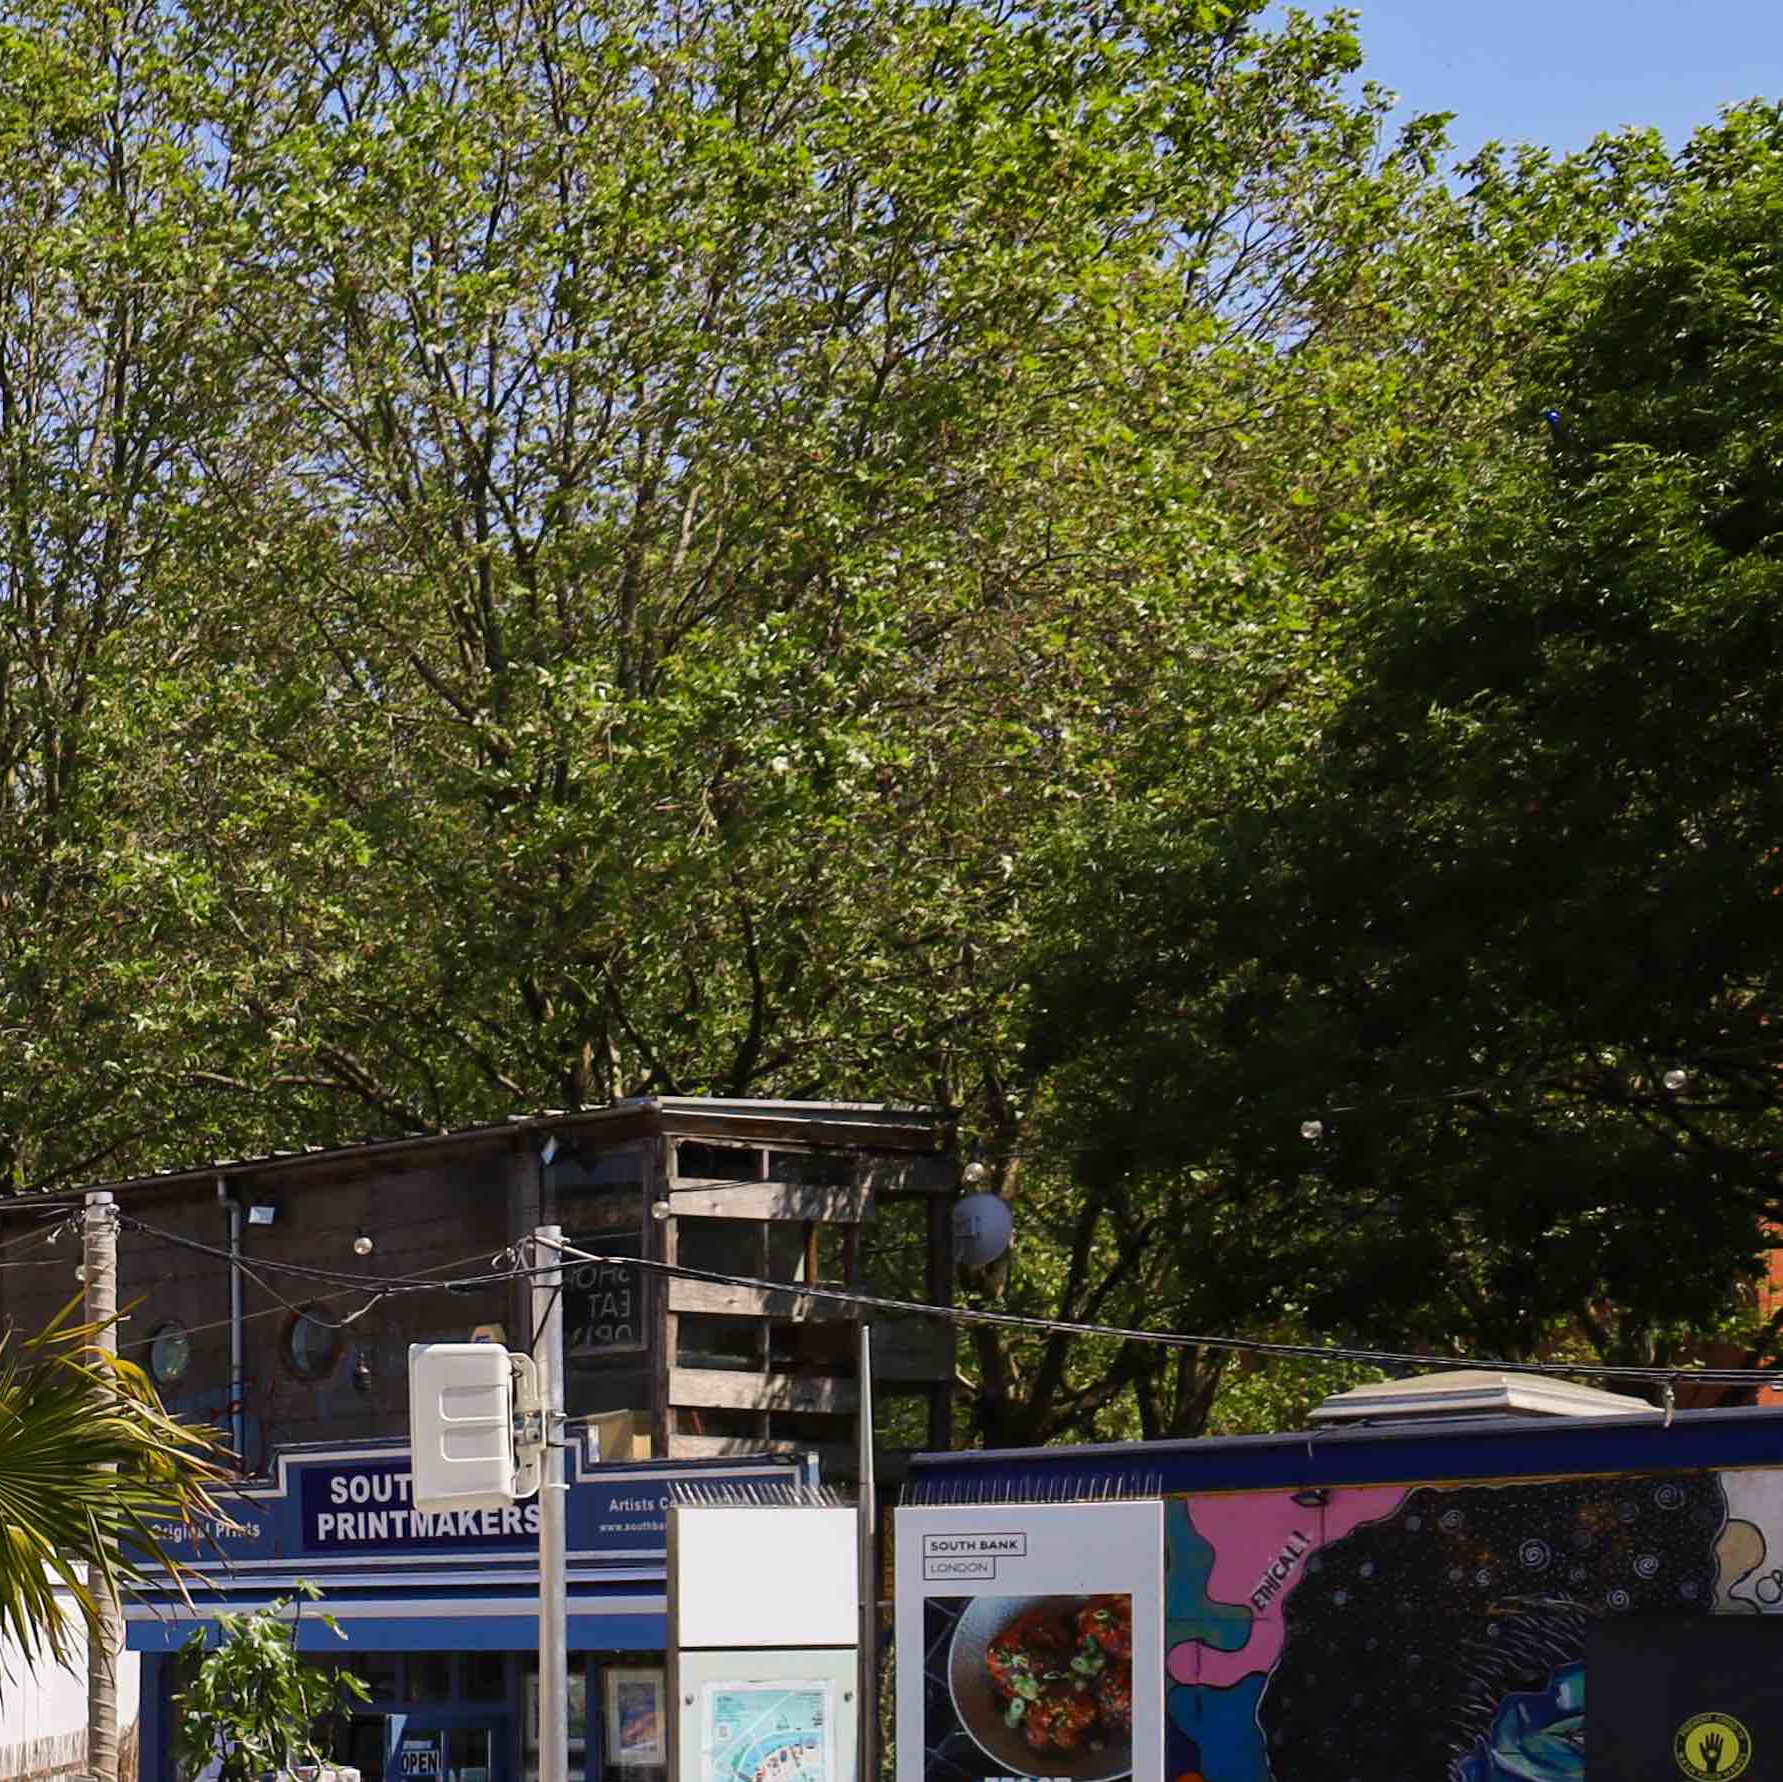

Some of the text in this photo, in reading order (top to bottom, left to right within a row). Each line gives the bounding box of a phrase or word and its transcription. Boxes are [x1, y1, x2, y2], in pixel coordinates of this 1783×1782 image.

[609, 1498, 655, 1512] Artists
[317, 1503, 540, 1540] PRINTMAKERS
[930, 1539, 1018, 1551] SOUTH BANK
[930, 1562, 988, 1573] LONDON
[402, 1752, 437, 1774] OPEN
